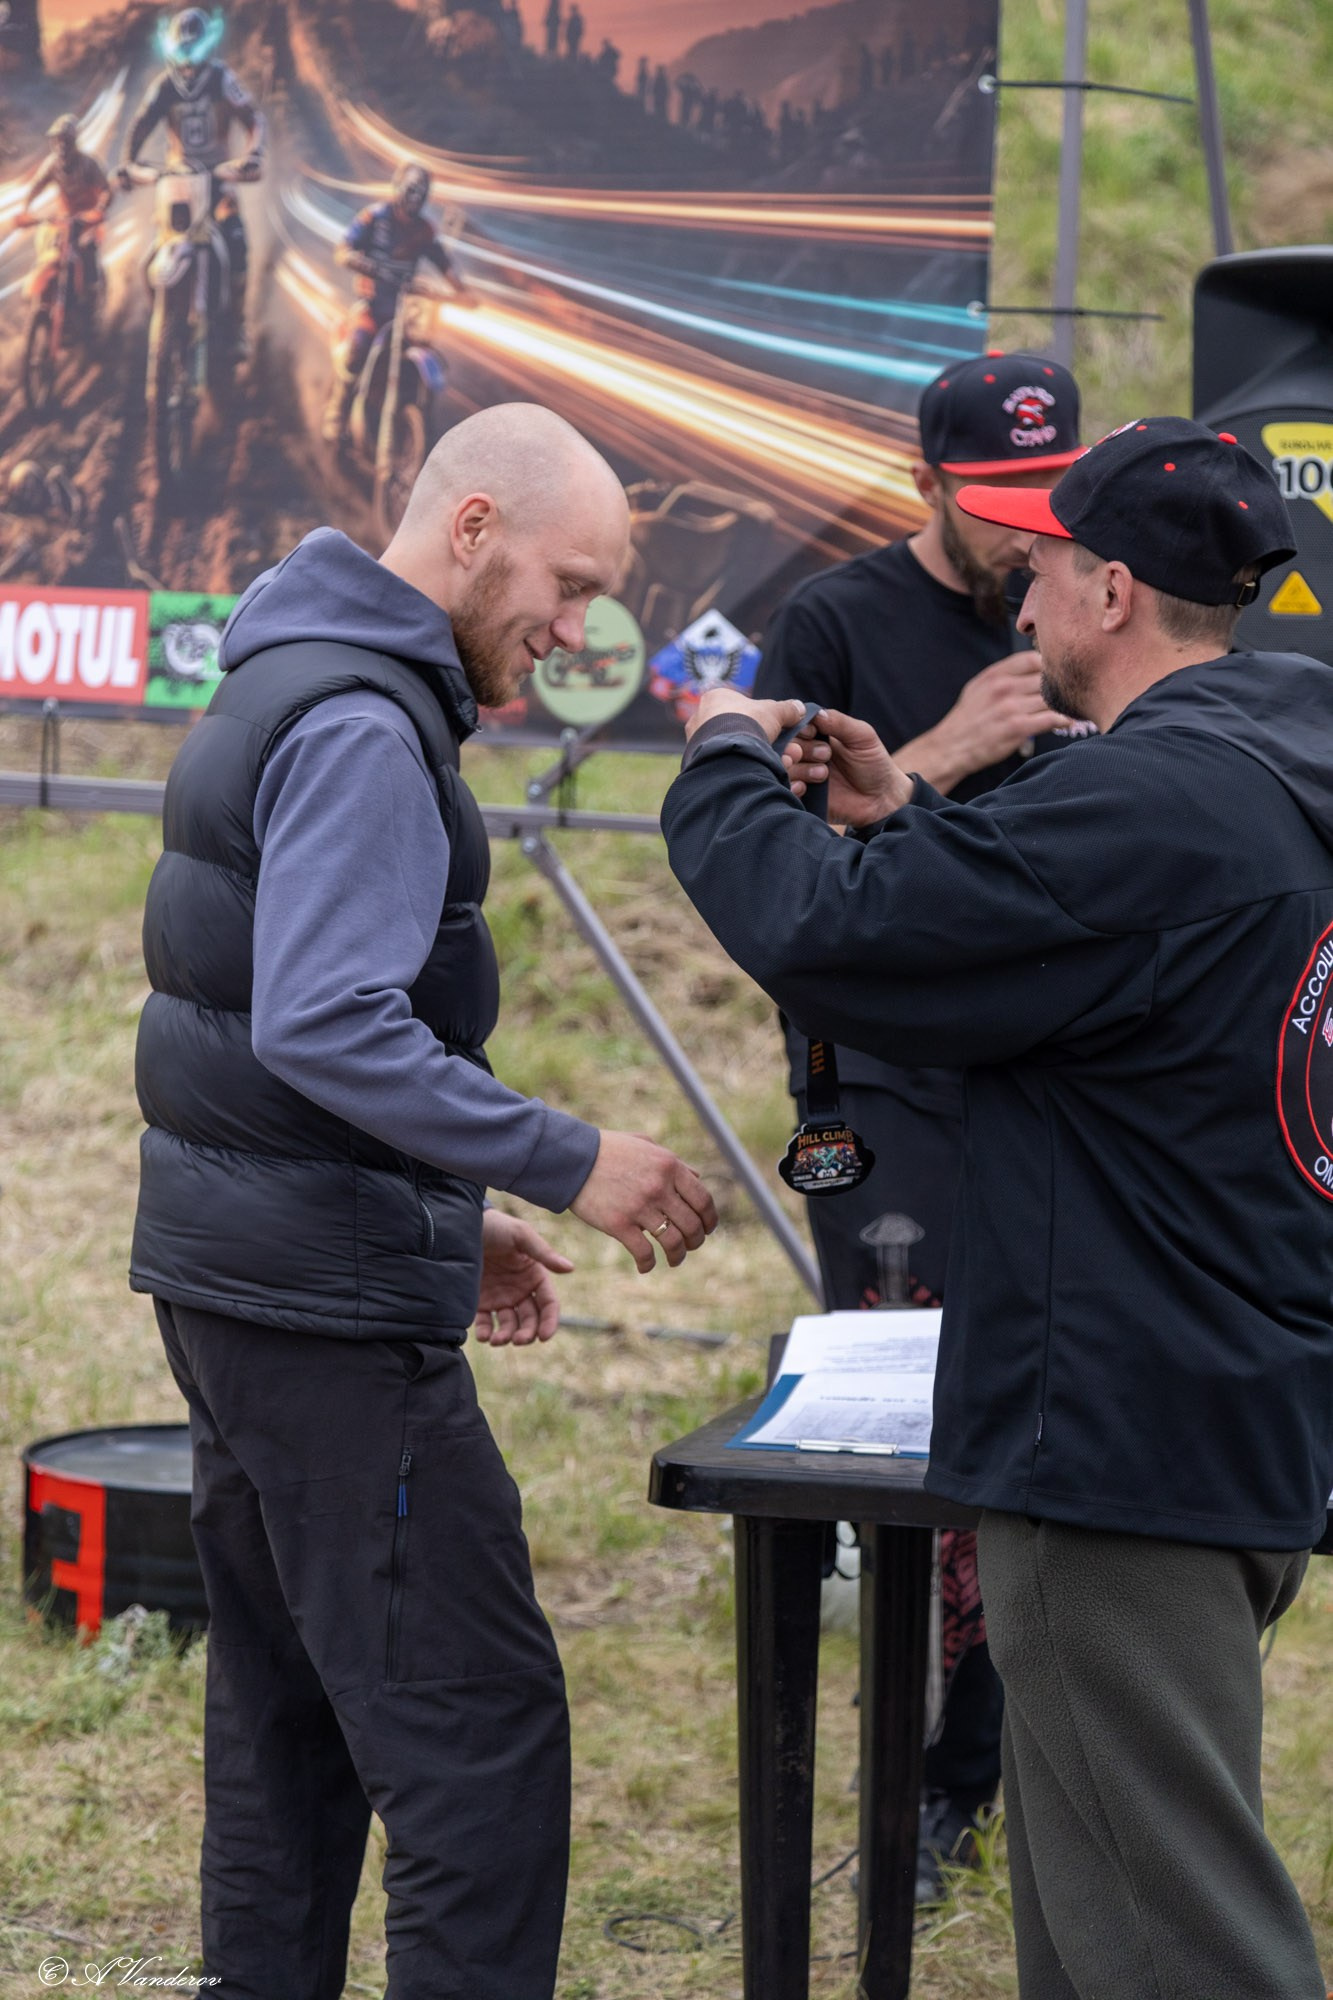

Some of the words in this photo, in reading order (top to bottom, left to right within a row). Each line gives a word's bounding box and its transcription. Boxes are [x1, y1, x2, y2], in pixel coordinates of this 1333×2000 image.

[1279, 460, 1333, 494] 10
[798, 1132, 821, 1150] HILL
[822, 1129, 854, 1143] CLIMB
